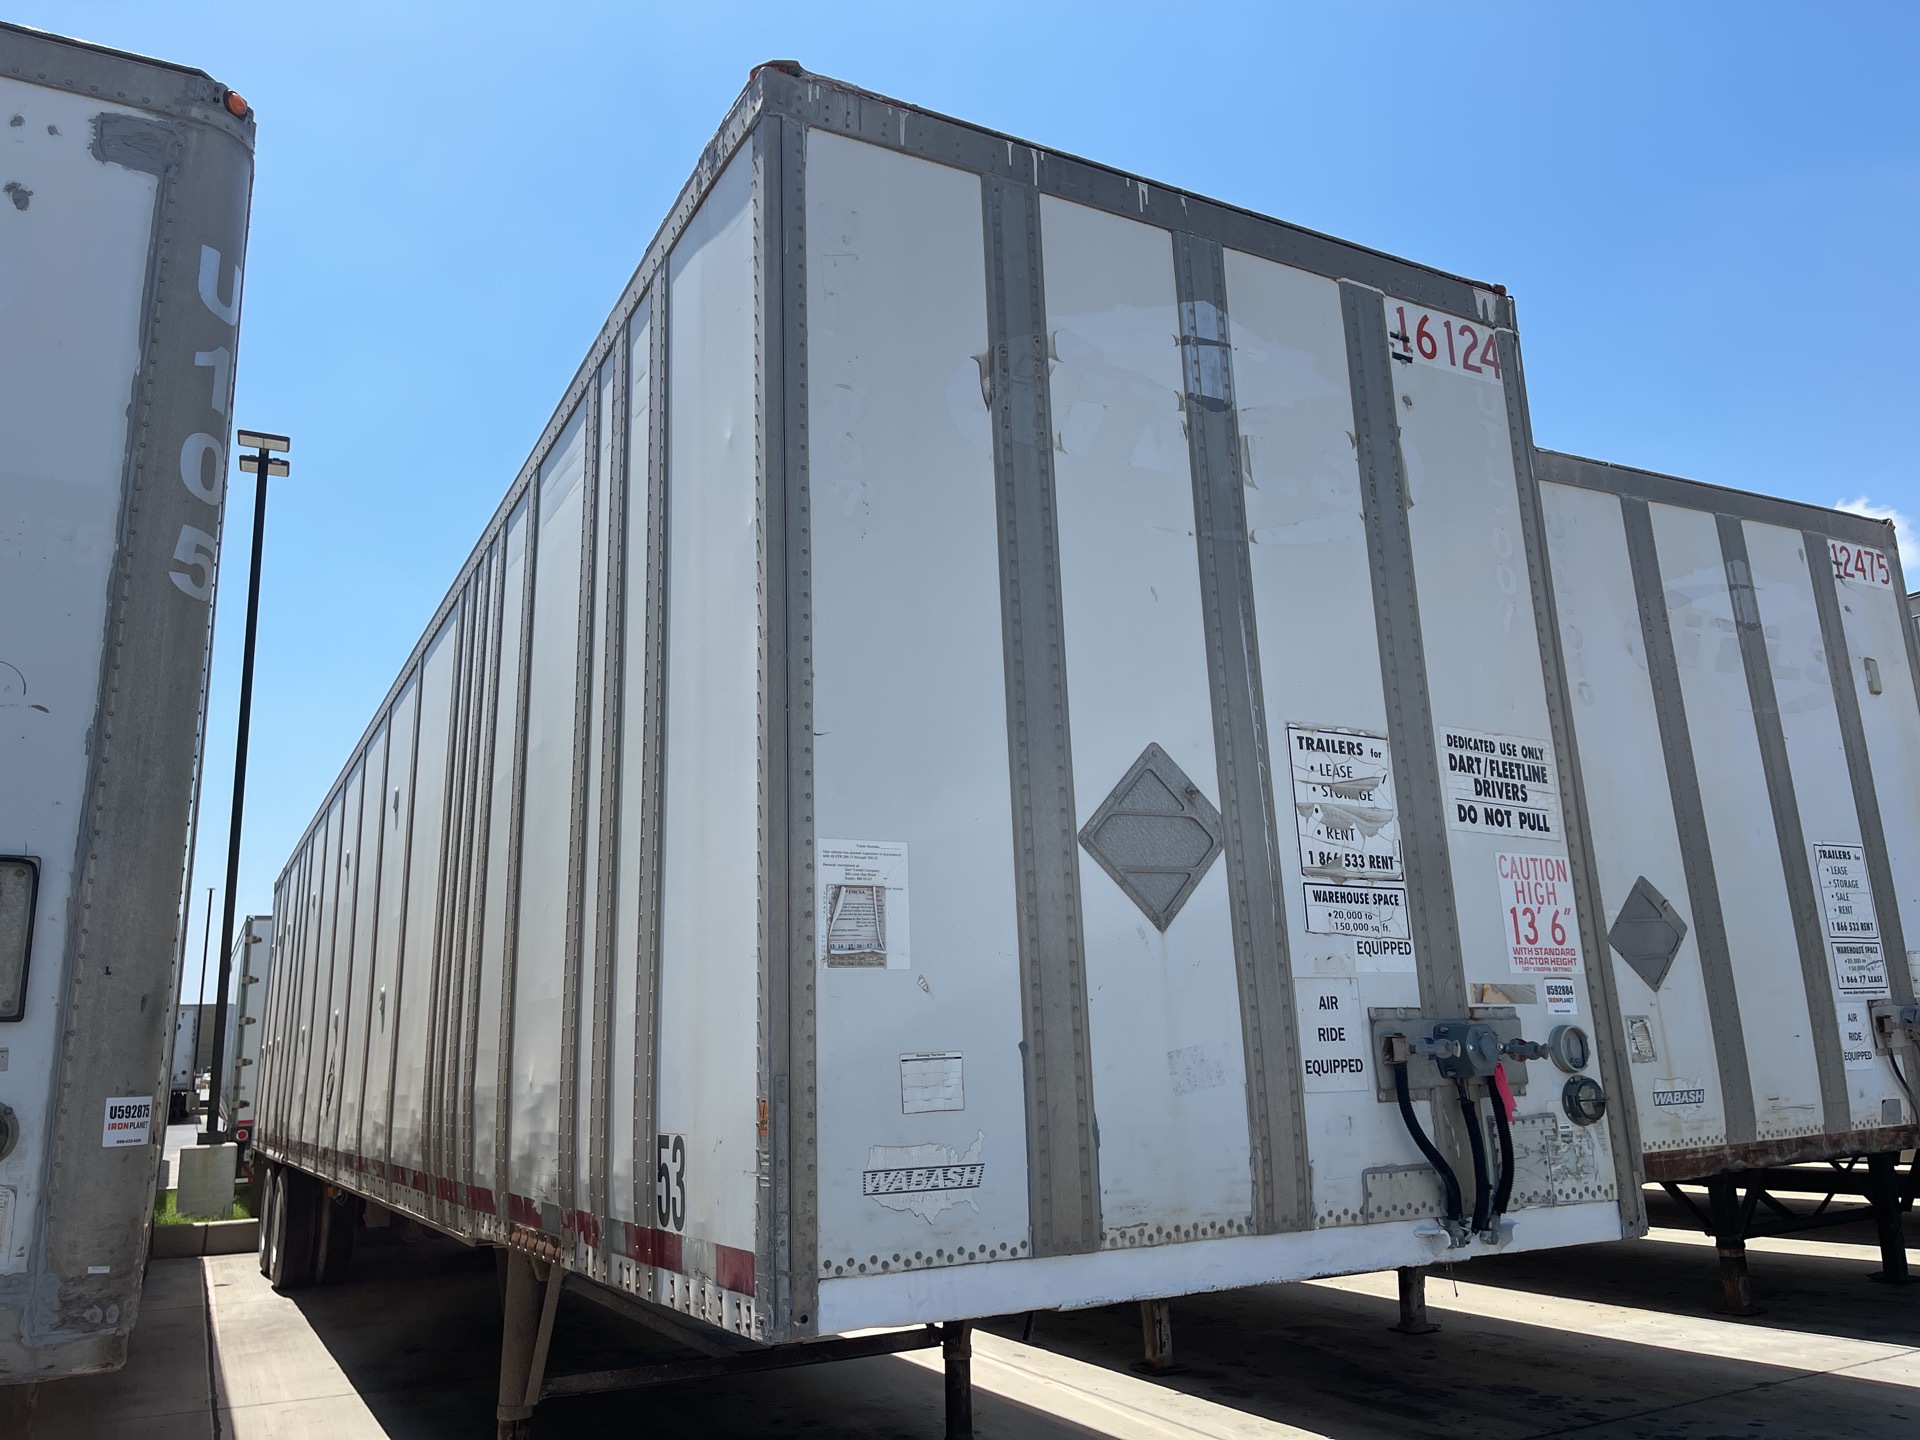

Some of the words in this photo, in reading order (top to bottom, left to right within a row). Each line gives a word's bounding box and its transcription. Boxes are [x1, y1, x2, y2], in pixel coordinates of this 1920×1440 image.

[1396, 306, 1501, 379] 16124
[1831, 544, 1890, 585] 12475
[1297, 736, 1364, 756] TRAILERS
[1370, 748, 1382, 758] for
[1446, 734, 1496, 754] DEDICATED
[1500, 742, 1518, 757] USE
[1521, 745, 1544, 761] ONLY
[1320, 763, 1354, 778] LEASE
[1448, 753, 1549, 784] DART/FLEETLINE
[1321, 784, 1374, 802] STGE
[1474, 778, 1528, 802] DRIVERS
[1457, 804, 1478, 824] DO
[1484, 807, 1512, 828] NOT
[1518, 812, 1551, 832] PULL
[1326, 826, 1355, 842] RENT
[1308, 850, 1314, 865] 1
[1344, 854, 1365, 868] 533
[1369, 854, 1394, 870] RENT
[1818, 850, 1851, 860] TRAILERS
[1498, 854, 1568, 882] CAUTION
[1830, 866, 1848, 875] LEASE
[1833, 879, 1859, 888] STORAGE
[1312, 890, 1370, 905] WAREHOUSE
[1373, 893, 1400, 906] SPACE
[1514, 880, 1558, 906] HIGH
[1836, 892, 1850, 901] SALE
[1333, 910, 1362, 920] 20,000
[1838, 906, 1853, 914] RENT
[1335, 922, 1369, 932] 150,000
[1382, 923, 1391, 932] ft.
[1832, 922, 1835, 931] 1
[1837, 922, 1848, 931] 866
[1849, 922, 1860, 931] 533
[1860, 922, 1874, 931] RENT
[1357, 941, 1412, 957] EQUIPPED
[1512, 947, 1534, 956] WITH
[1534, 947, 1576, 956] STANDARD
[1836, 946, 1864, 954] WAREHOUSE
[1513, 957, 1549, 966] TRACTOR
[1551, 958, 1577, 966] HEIGHT
[1319, 996, 1338, 1010] AIR
[1848, 1013, 1858, 1022] AIR
[1318, 1027, 1346, 1042] RIDE
[1848, 1032, 1862, 1041] RIDE
[1844, 1051, 1872, 1062] EQUIPPED
[1305, 1058, 1364, 1077] EQUIPPED
[1654, 1090, 1704, 1106] WABASH
[109, 1104, 150, 1120] U592875
[658, 1134, 685, 1232] 53
[866, 1166, 980, 1194] WABASH
